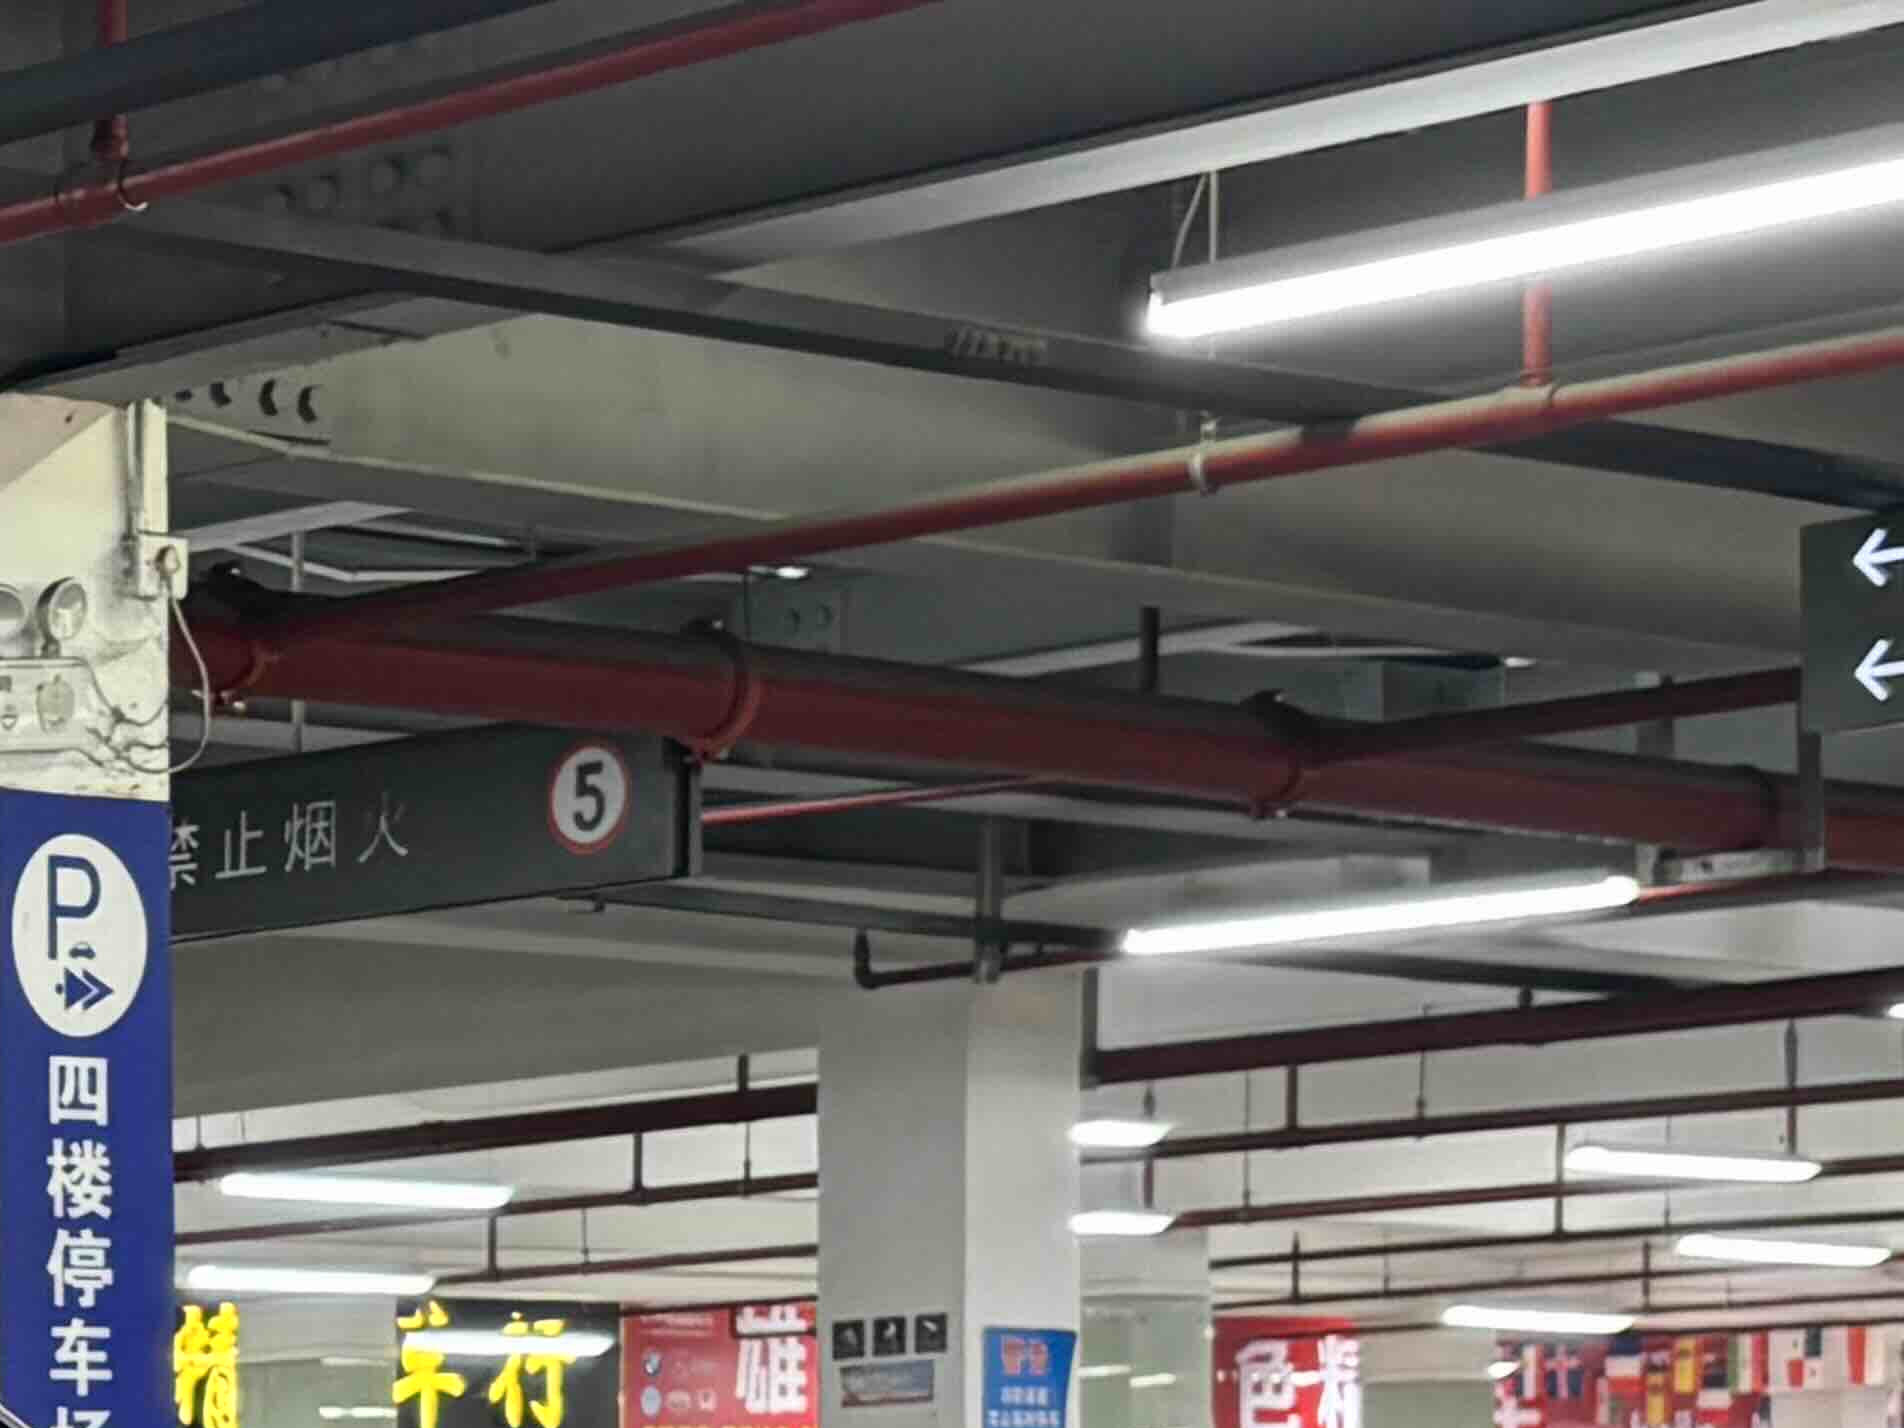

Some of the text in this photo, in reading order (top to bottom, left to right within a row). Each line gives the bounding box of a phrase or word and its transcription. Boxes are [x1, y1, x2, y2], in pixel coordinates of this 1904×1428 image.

[168, 793, 409, 890] 禁止烟火
[572, 759, 607, 834] 5
[46, 854, 102, 962] P
